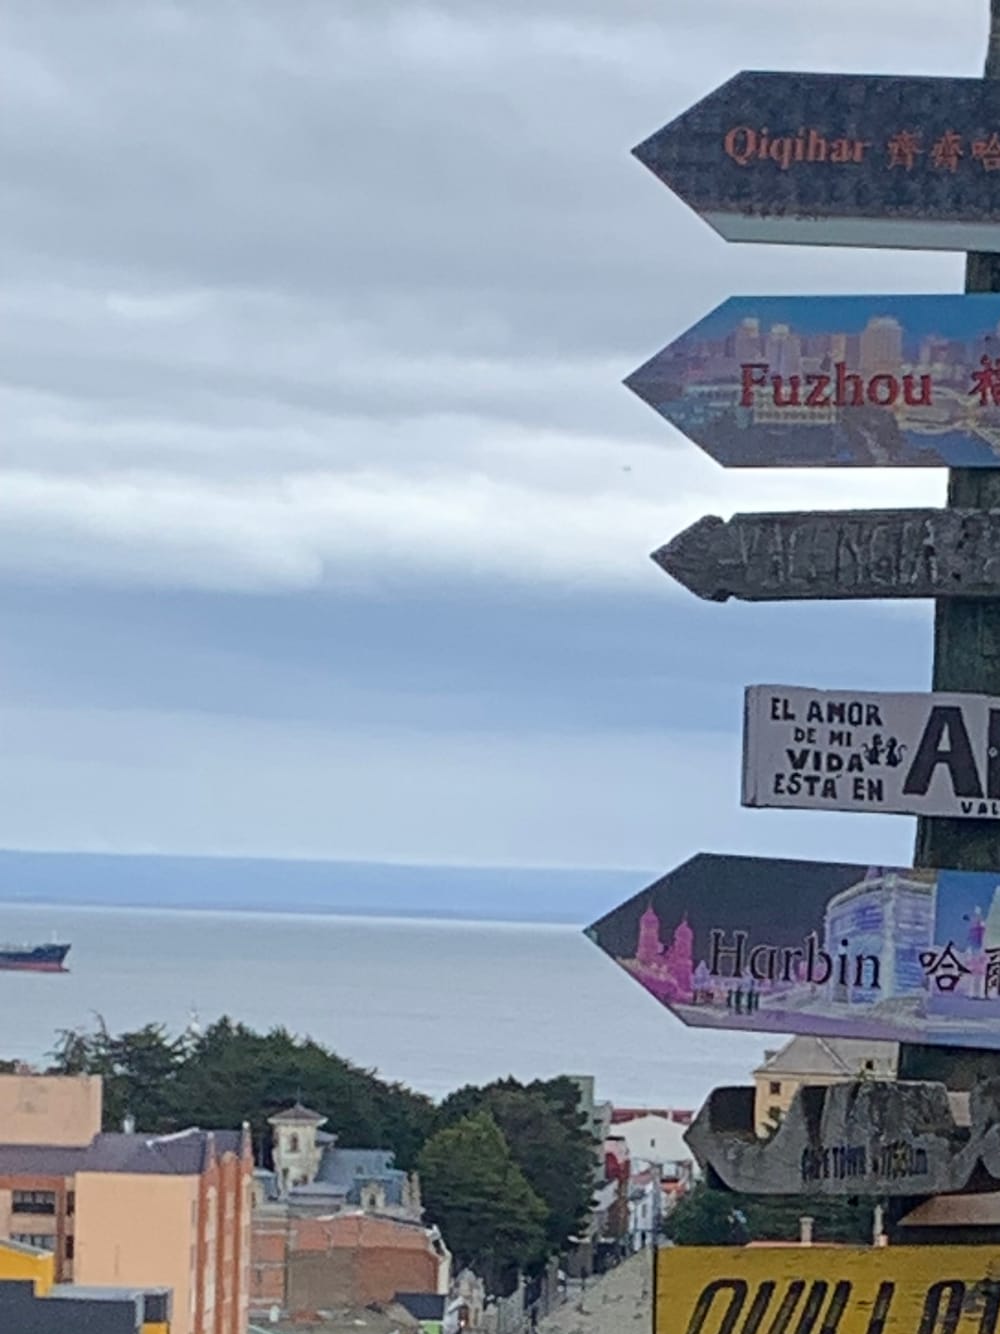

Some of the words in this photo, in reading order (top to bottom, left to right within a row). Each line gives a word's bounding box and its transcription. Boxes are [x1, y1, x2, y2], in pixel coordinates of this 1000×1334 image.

[723, 126, 868, 171] Qiqihar
[739, 361, 933, 407] Fuzhou
[770, 697, 796, 721] EL
[806, 701, 883, 727] AMOR
[793, 727, 817, 745] DE
[828, 731, 852, 748] MI
[785, 748, 865, 773] VIDA
[853, 778, 884, 801] EN
[709, 928, 881, 990] Harbin
